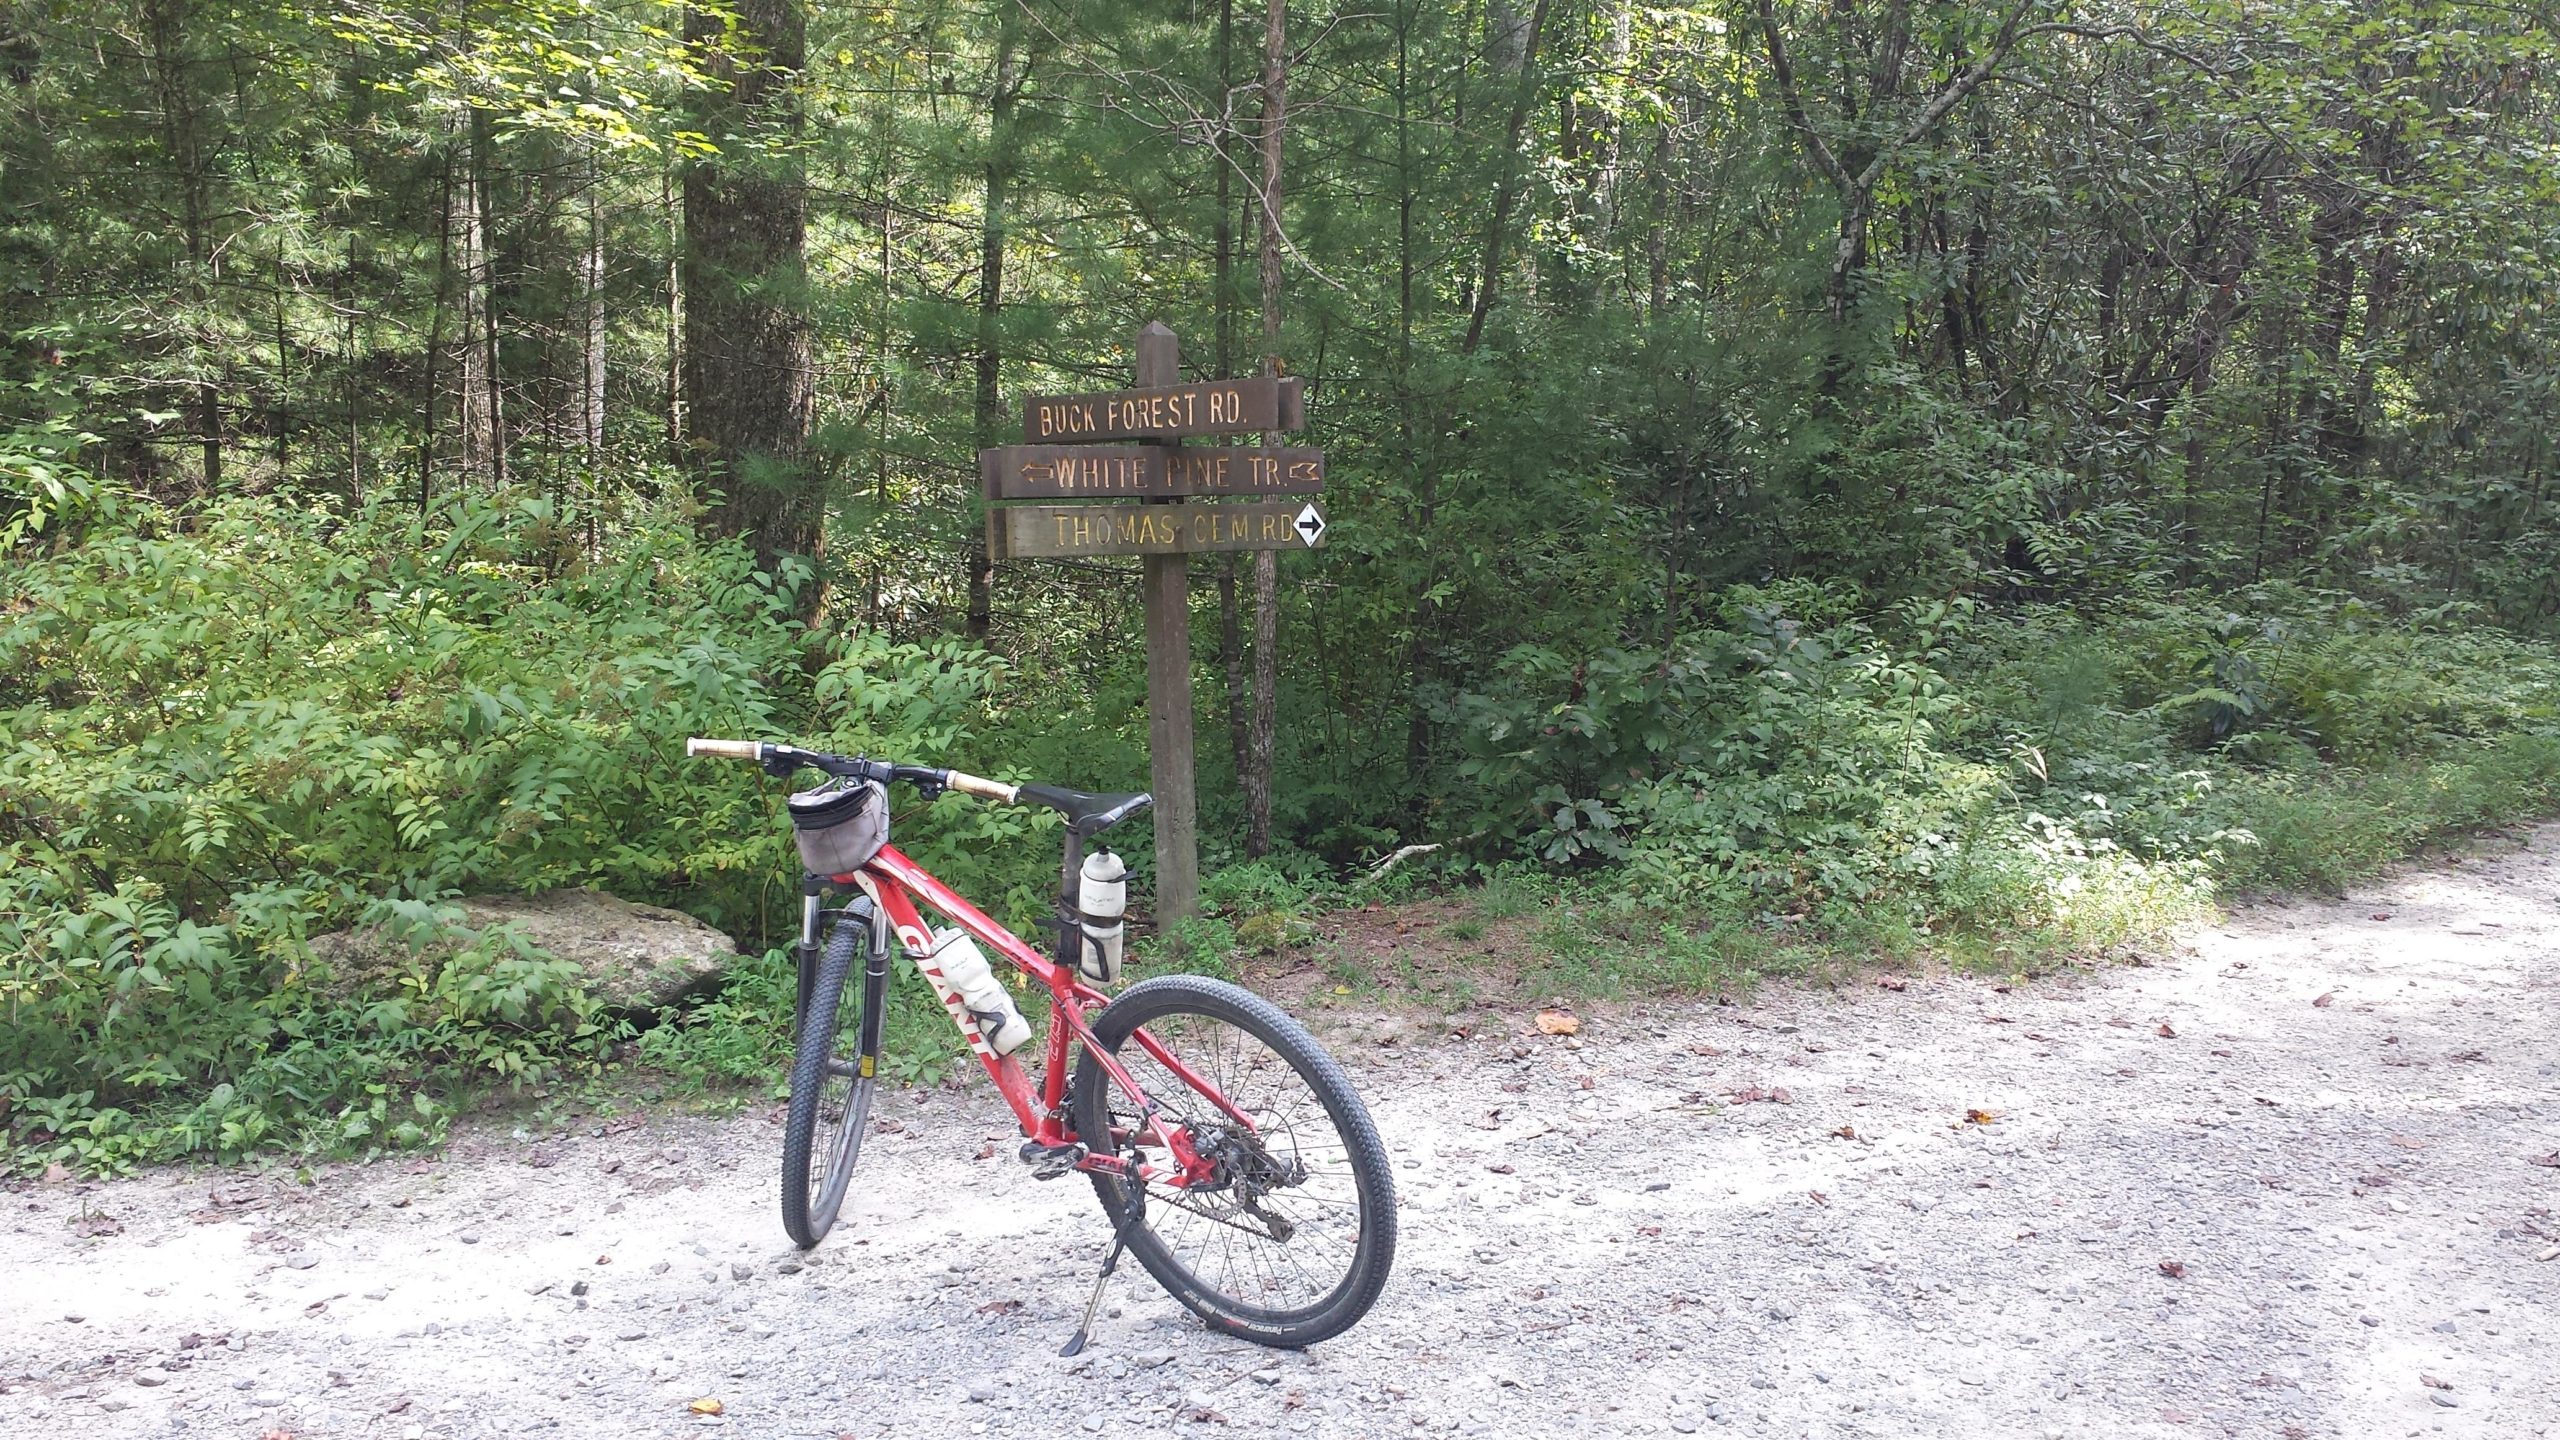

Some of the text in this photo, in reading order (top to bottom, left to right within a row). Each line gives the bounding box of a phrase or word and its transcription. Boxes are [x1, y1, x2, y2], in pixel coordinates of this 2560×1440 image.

[1040, 390, 1248, 437] BUCK FOREST RD.
[1055, 456, 1288, 488] WHITE PINE TR.
[1053, 513, 1175, 547] THOMAS
[897, 924, 1000, 1061] GIANT
